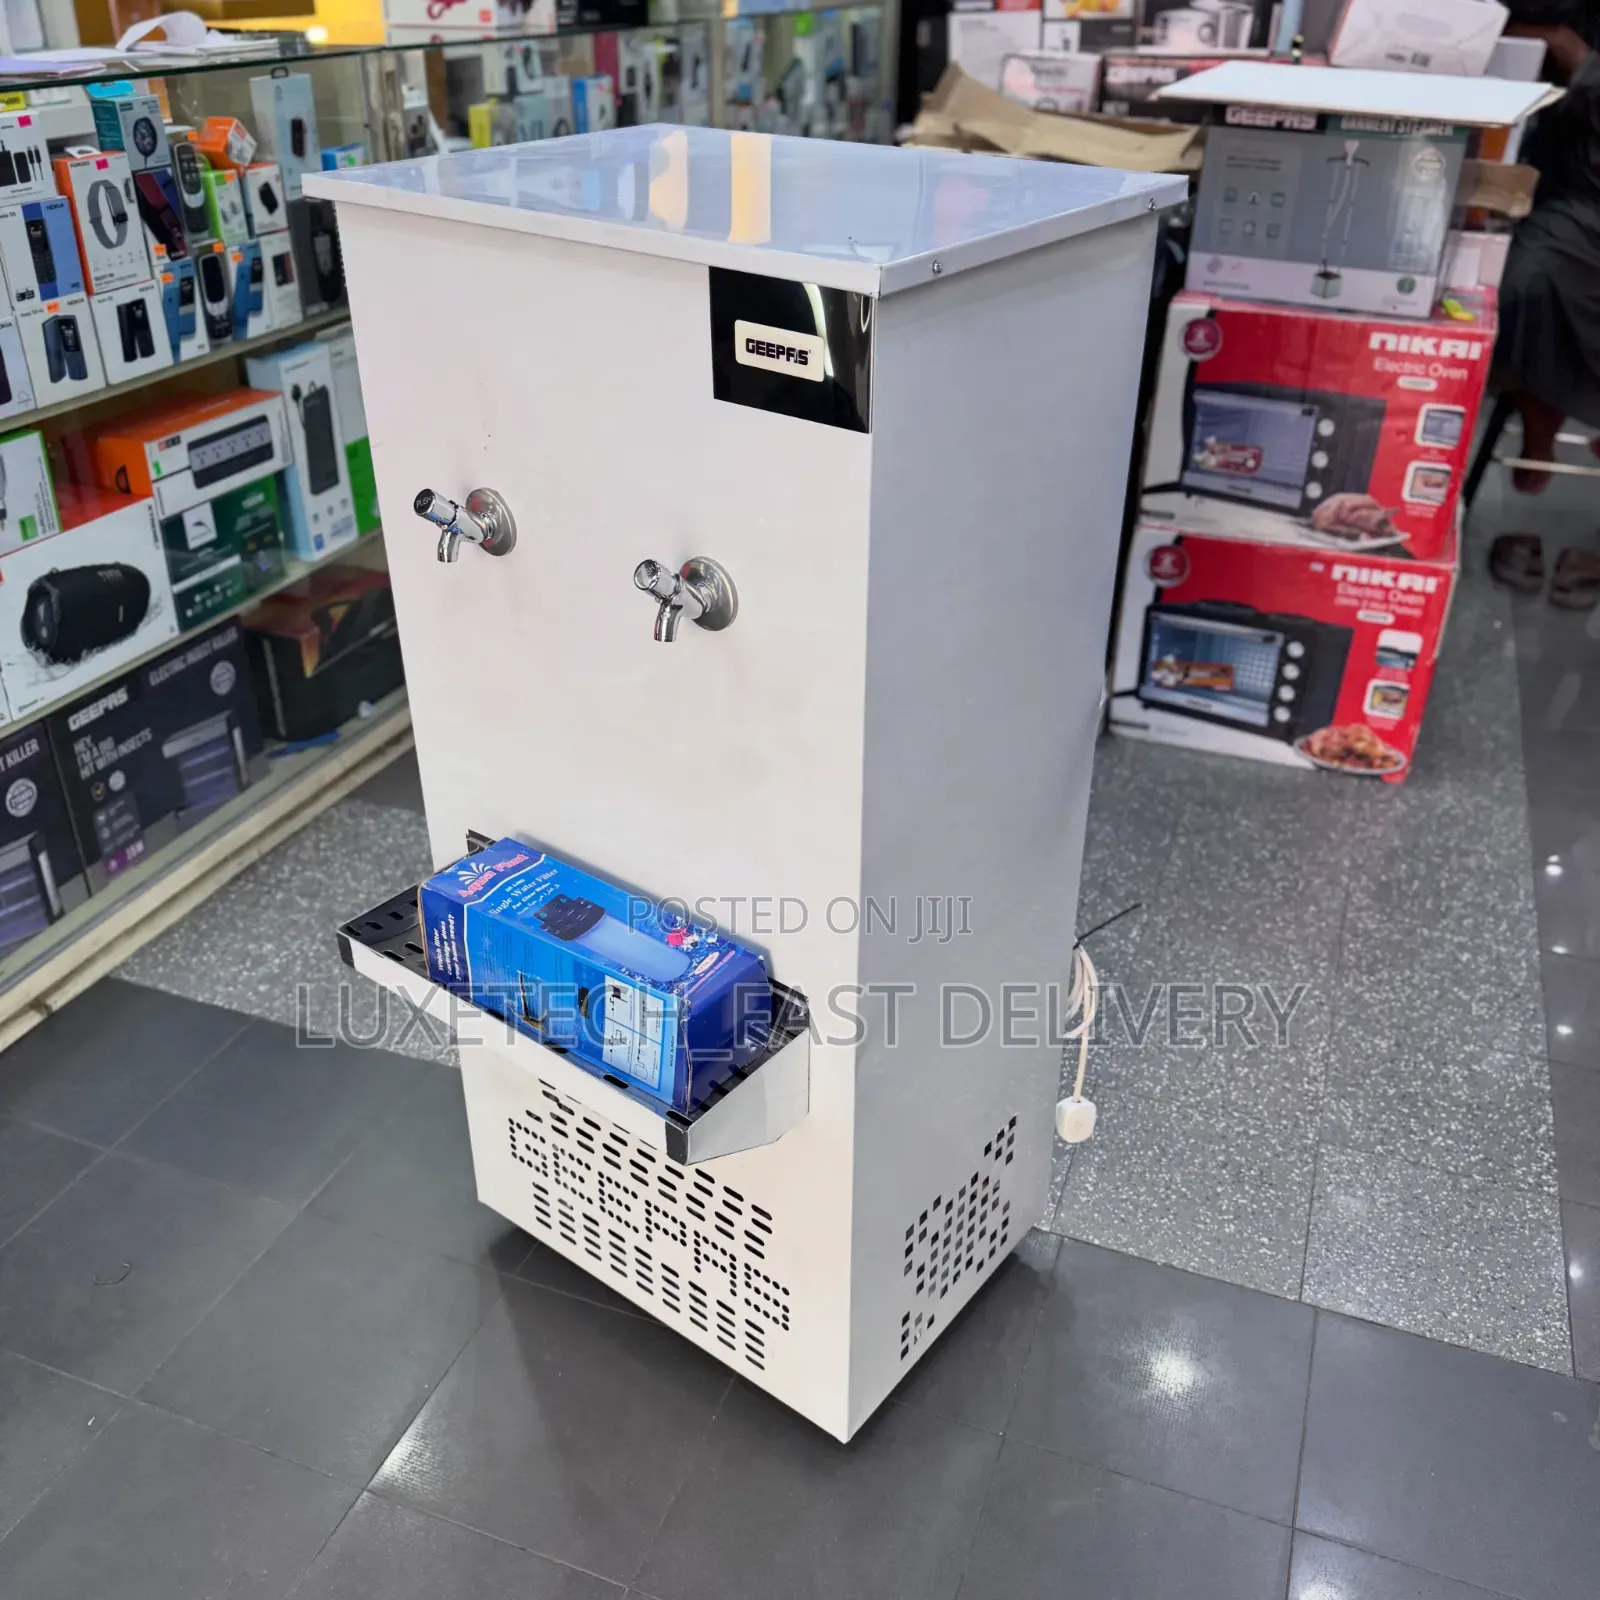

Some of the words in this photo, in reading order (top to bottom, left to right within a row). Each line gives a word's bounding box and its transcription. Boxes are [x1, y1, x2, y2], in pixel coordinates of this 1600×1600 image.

[745, 338, 809, 366] GEEPAS
[1428, 362, 1468, 380] Oven
[415, 496, 433, 510] PUSH
[1387, 589, 1426, 606] Oven
[68, 685, 129, 732] GEEPAS
[5, 738, 41, 769] KILLER
[458, 870, 497, 898] Aqua
[511, 881, 537, 897] Water
[536, 869, 559, 883] Filter
[433, 927, 441, 947] filter
[436, 947, 444, 971] Which
[444, 940, 452, 976] cartridge
[451, 940, 459, 962] home
[454, 962, 462, 981] your
